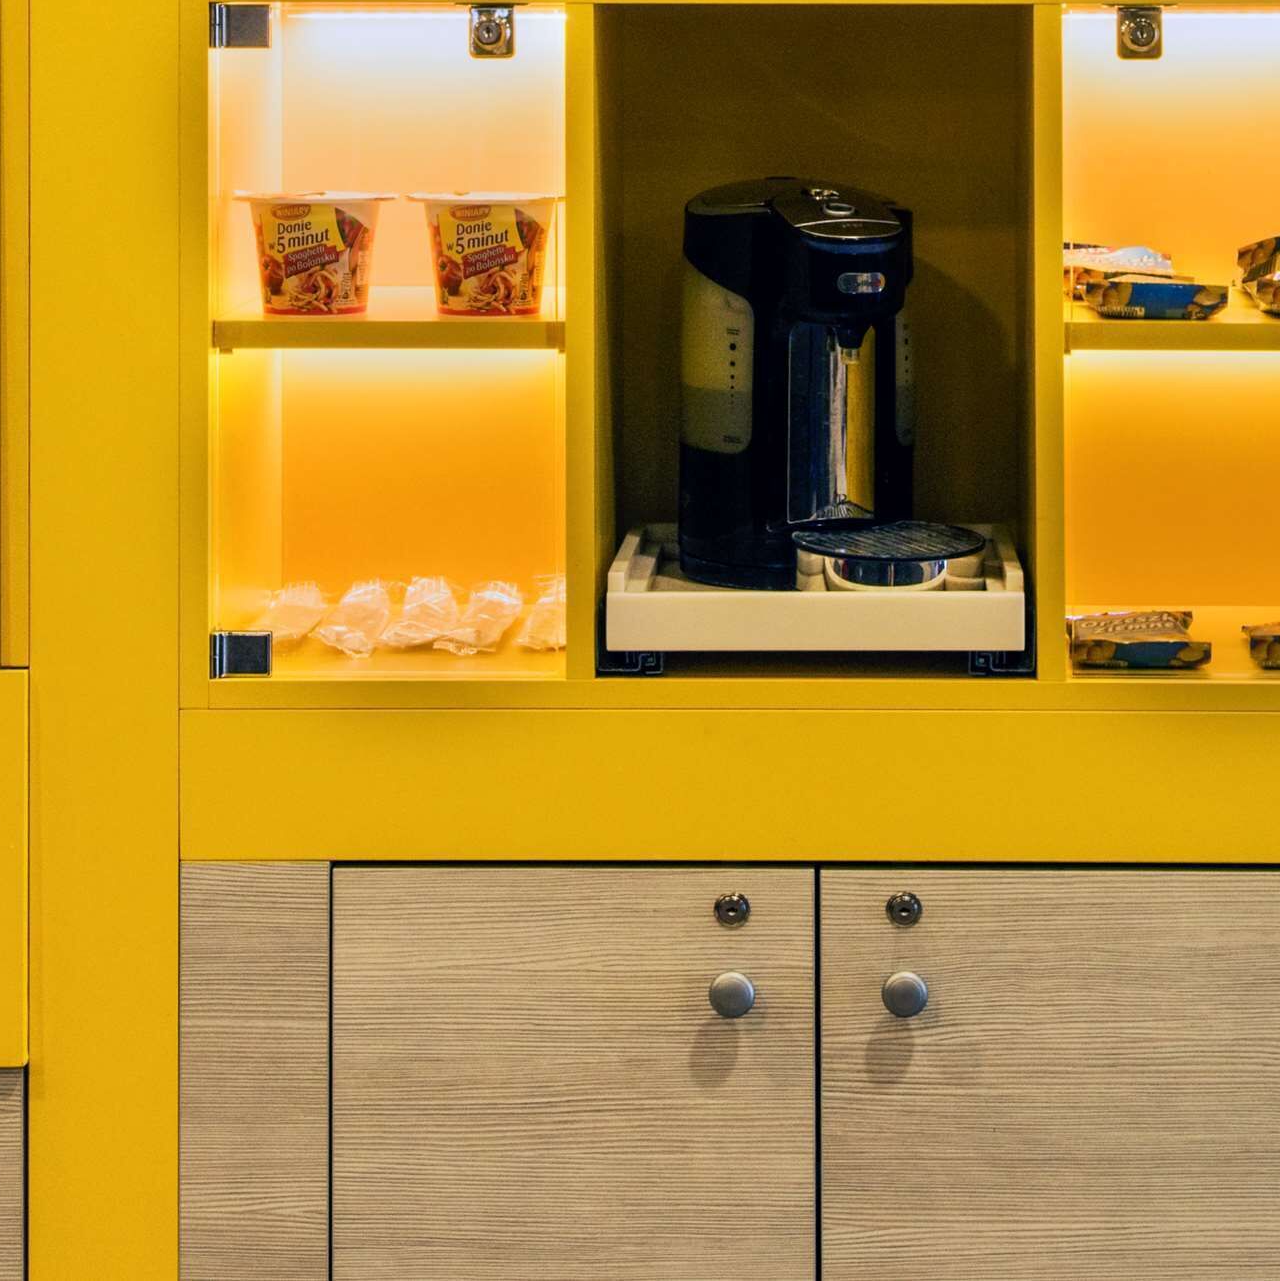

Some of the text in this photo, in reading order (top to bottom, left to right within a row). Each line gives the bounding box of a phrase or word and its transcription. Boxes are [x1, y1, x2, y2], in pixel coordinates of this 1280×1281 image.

[277, 221, 312, 235] Danie
[456, 221, 493, 236] Danie
[277, 236, 286, 254] 5
[288, 228, 330, 248] minut
[455, 237, 465, 254] 5
[467, 229, 509, 249] minut
